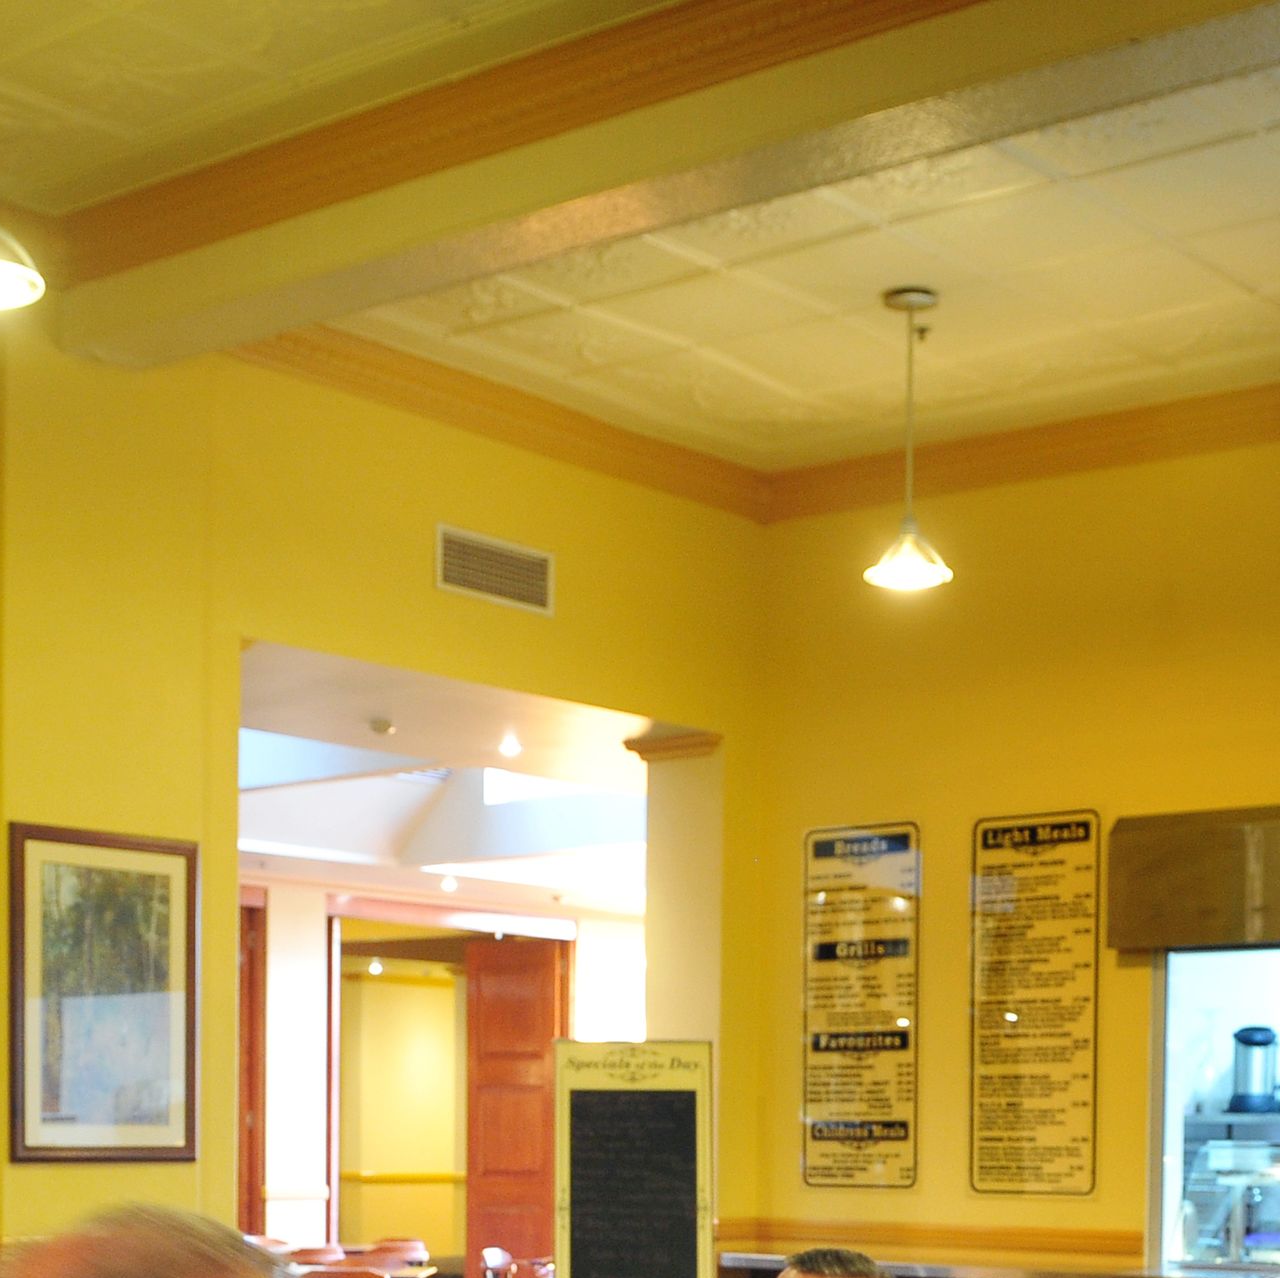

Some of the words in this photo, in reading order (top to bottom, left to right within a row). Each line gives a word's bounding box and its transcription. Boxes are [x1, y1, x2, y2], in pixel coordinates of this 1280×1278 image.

[987, 827, 1030, 847] Light
[1036, 823, 1086, 842] Meals
[836, 942, 886, 958] Grills
[819, 1033, 902, 1049] Favourites
[566, 1057, 631, 1072] Specials
[669, 1057, 699, 1071] Day
